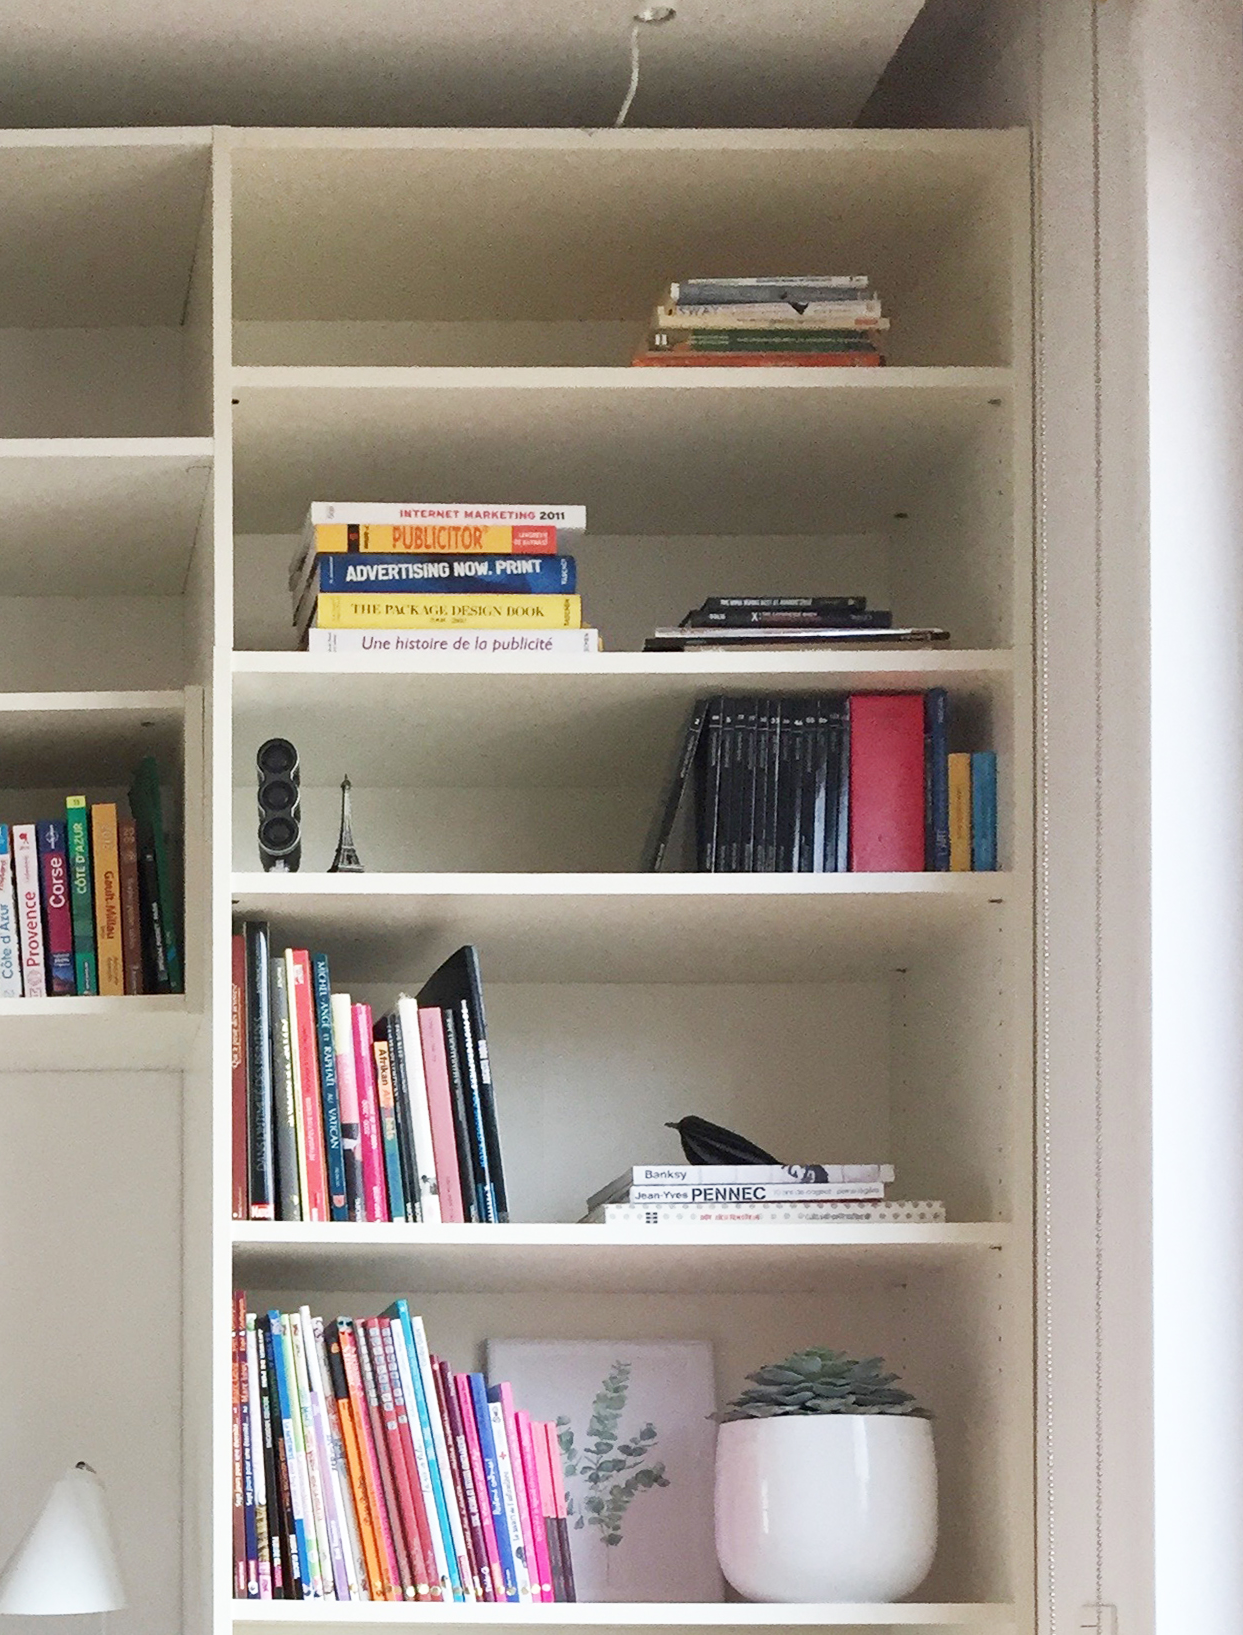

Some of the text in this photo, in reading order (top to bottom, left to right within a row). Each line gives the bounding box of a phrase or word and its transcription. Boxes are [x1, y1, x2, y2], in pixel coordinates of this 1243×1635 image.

[399, 509, 565, 521] INTERNET MARKETING 2011
[392, 526, 484, 550] PUBLICITOR
[346, 559, 543, 583] ADVERTISING NOW. PRINT
[351, 603, 545, 617] THE PACKAGE DESIGN BOOK
[362, 636, 553, 653] Une histoire de la publicité
[72, 823, 87, 894] CÔTE D'AZUR
[49, 857, 65, 908] Corse
[24, 891, 40, 967] Provence
[0, 948, 14, 979] Côte
[377, 1048, 389, 1086] Afrikan
[327, 1108, 339, 1149] VATICAN
[644, 1168, 688, 1182] Banksy
[634, 1189, 689, 1201] Jean-Yves
[692, 1186, 766, 1201] PENNEC
